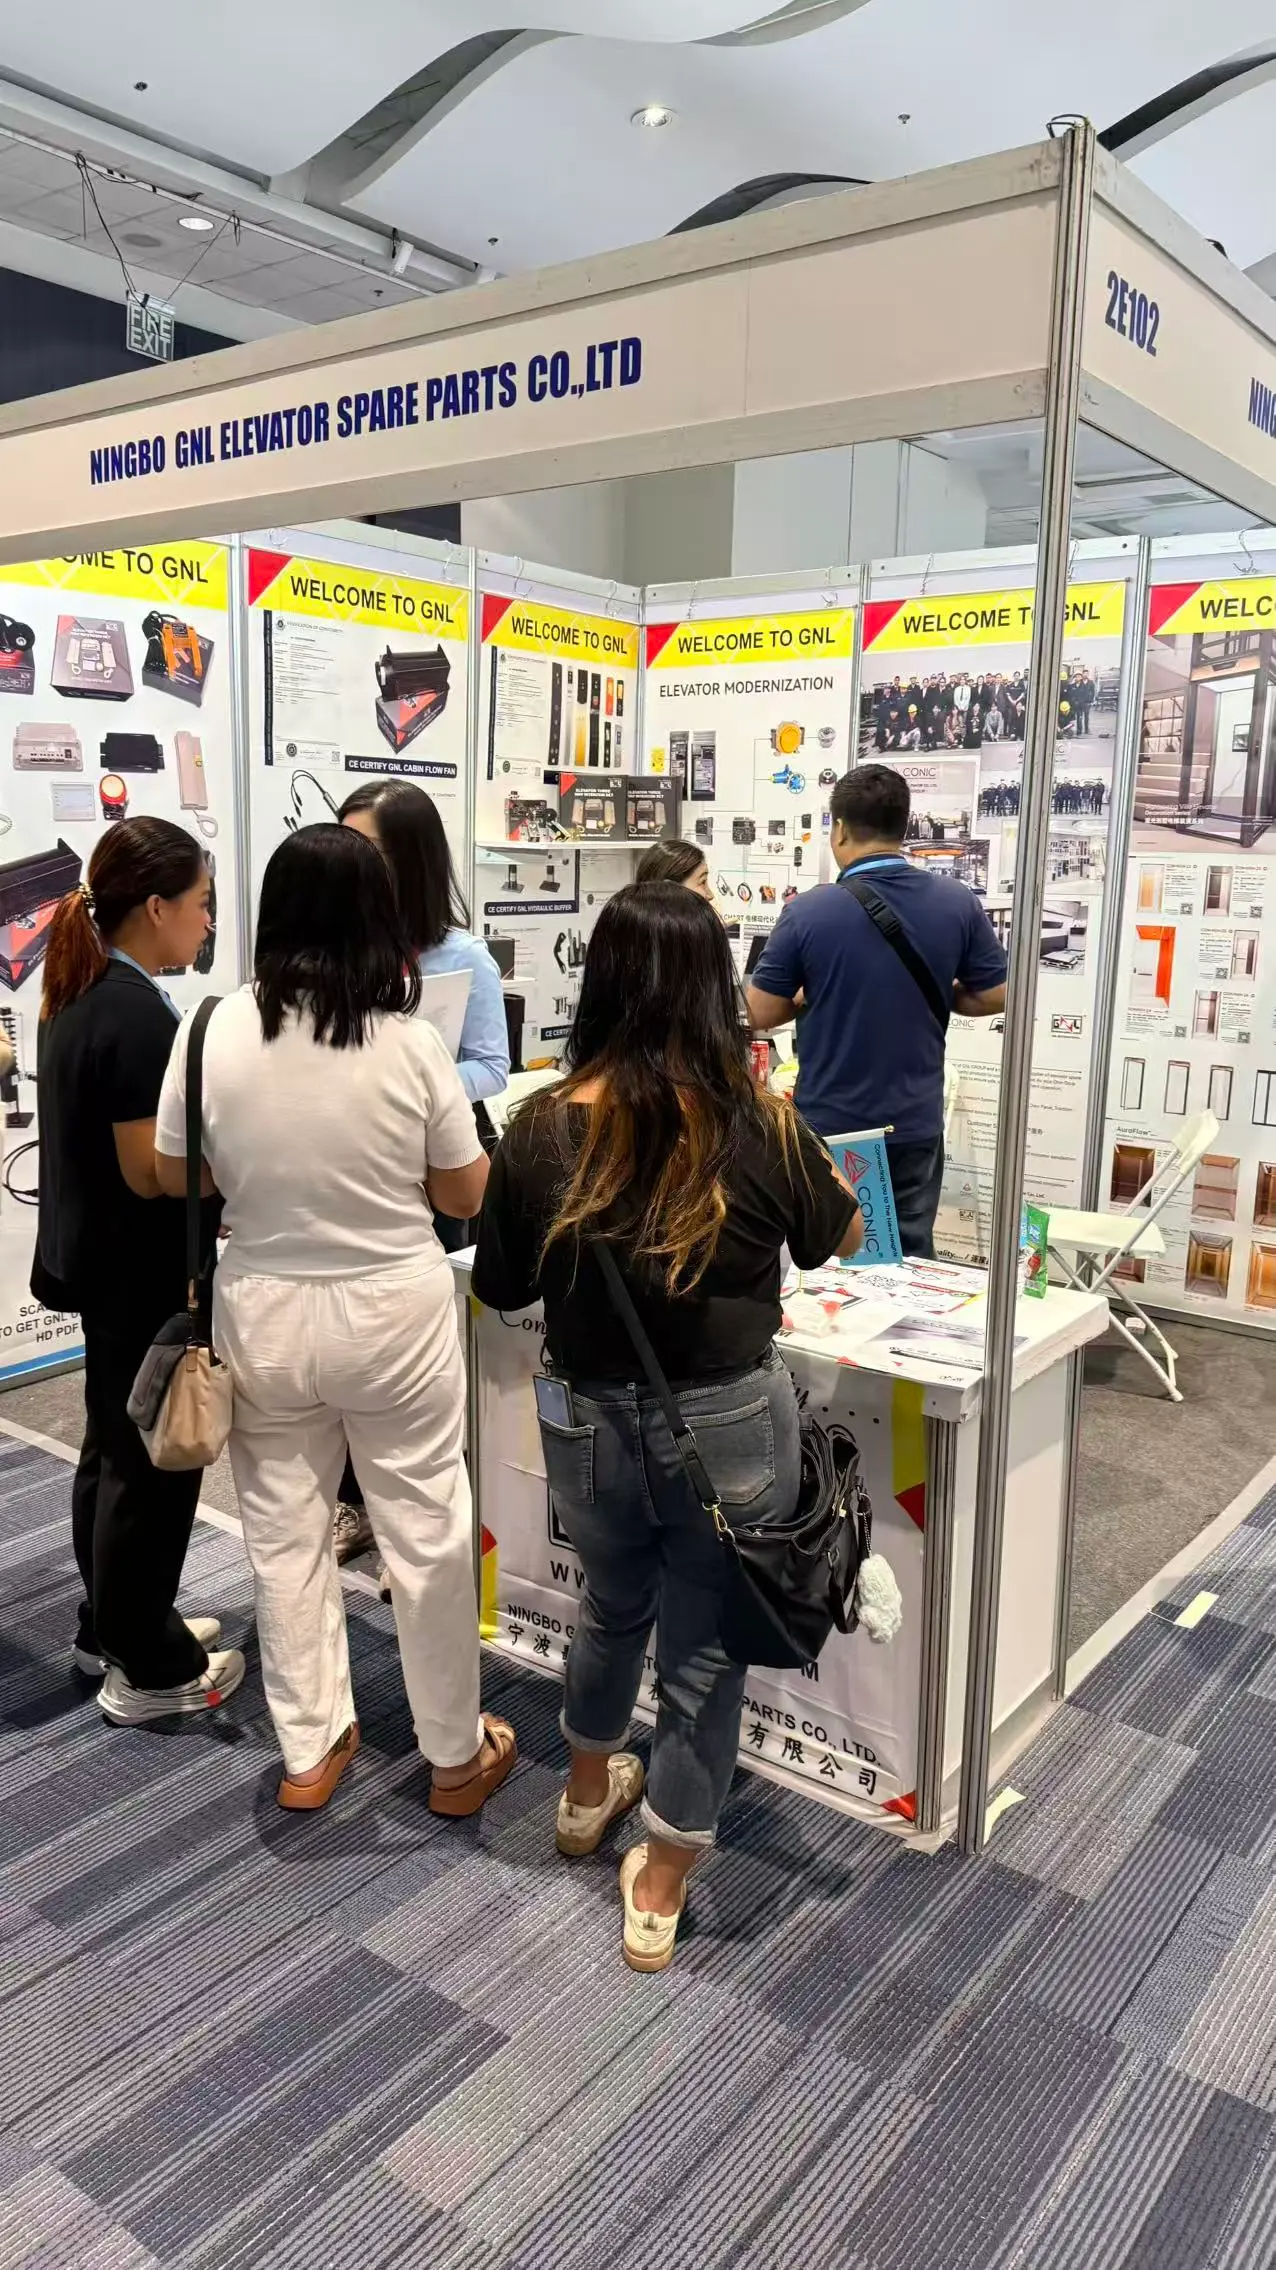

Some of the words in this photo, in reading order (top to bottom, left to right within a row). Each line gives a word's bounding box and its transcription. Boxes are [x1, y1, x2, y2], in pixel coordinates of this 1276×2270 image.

[130, 303, 171, 335] FIRE
[1105, 271, 1160, 357] 2E102
[130, 326, 171, 358] EXIT
[90, 436, 166, 485] NINGBO
[175, 426, 215, 469] GNL
[220, 401, 330, 461] ELEVATOR
[337, 381, 419, 438] SPARE
[426, 361, 517, 422] PARTS
[1248, 376, 1276, 440] NING
[122, 549, 154, 574] TO
[162, 556, 209, 583] GNL
[291, 575, 387, 611] WELCOME
[392, 594, 415, 616] TO
[421, 600, 455, 624] GNL
[1200, 595, 1276, 619] WELC
[511, 615, 580, 645] WELCOME
[584, 630, 599, 649] TO
[602, 634, 628, 654] GNL
[903, 608, 1011, 633] WELCOME
[1018, 607, 1033, 625] T
[678, 631, 764, 653] WELCOME
[770, 629, 793, 647] TO
[799, 626, 836, 645] GNL
[659, 682, 721, 698] ELEVATOR
[724, 676, 834, 695] MODERNIZATION
[348, 760, 359, 768] CE
[360, 760, 387, 770] CERTIFY
[388, 763, 402, 772] GNL
[403, 764, 424, 773] CABIN
[425, 766, 443, 775] FLOW
[443, 767, 456, 775] FAN
[903, 767, 937, 777] CONIC
[496, 905, 517, 913] CERTIFY
[857, 1186, 880, 1253] CONIC
[16, 1318, 41, 1333] GET
[44, 1312, 68, 1326] GNL
[20, 1302, 47, 1316] SCA
[36, 1330, 53, 1343] HD
[56, 1322, 79, 1338] PDF
[507, 1603, 561, 1633] NINGBO
[565, 1624, 575, 1639] G
[742, 1695, 796, 1730] PARTS
[801, 1720, 837, 1750] CO.,
[842, 1737, 882, 1766] LTD.
[746, 1720, 878, 1796] 有限公司
